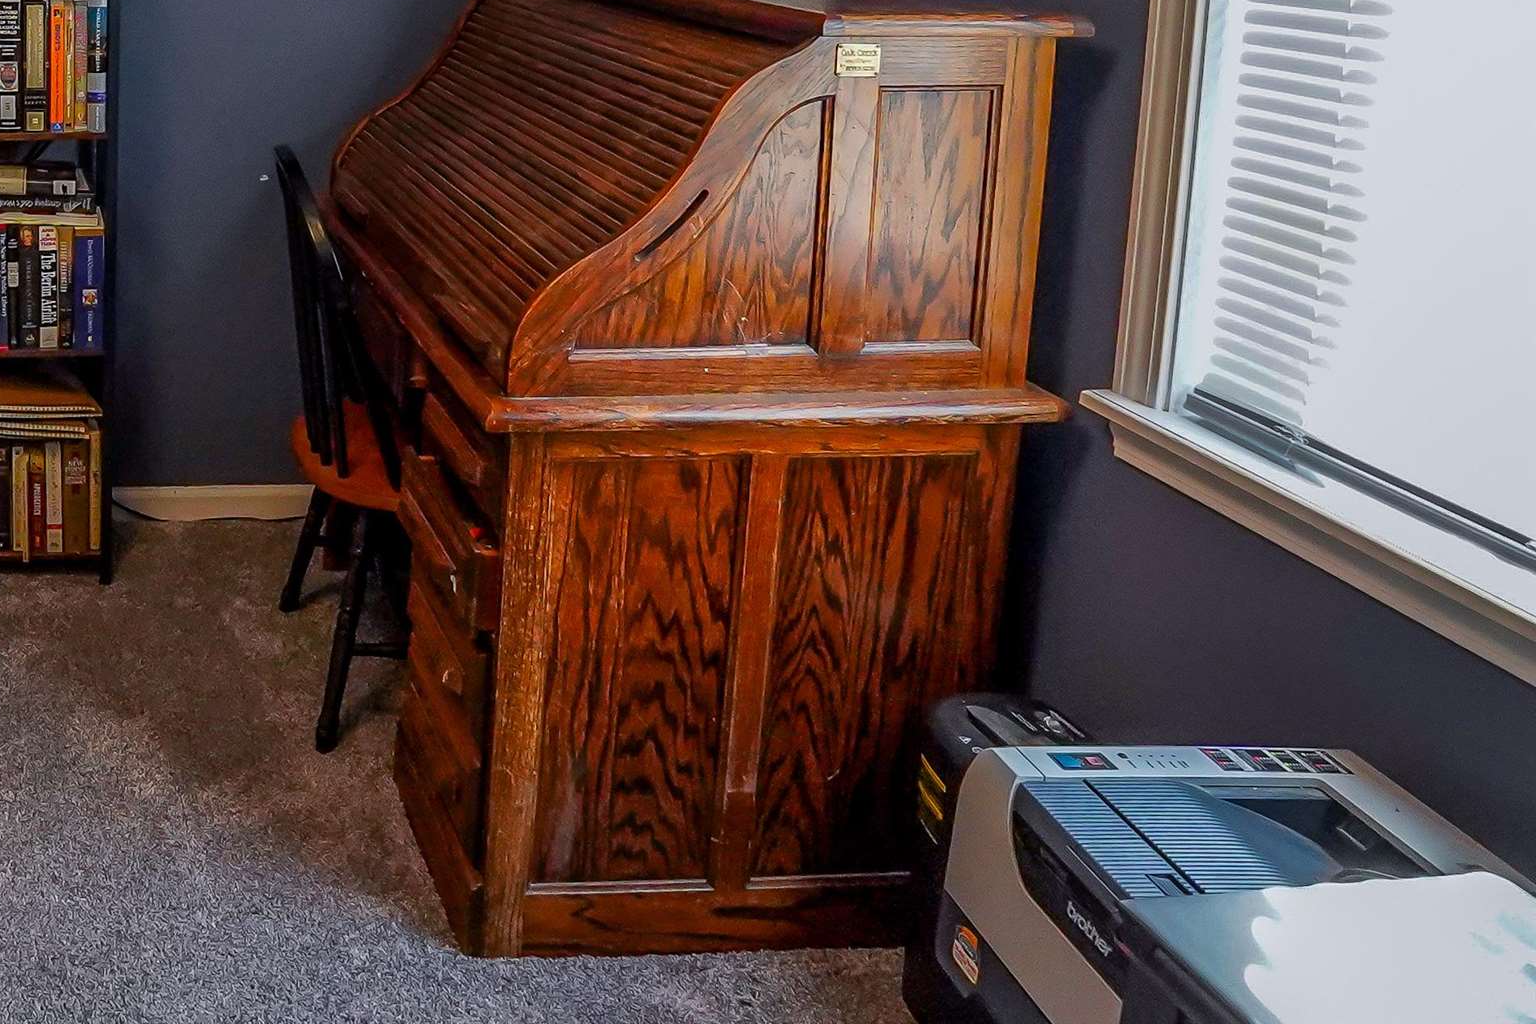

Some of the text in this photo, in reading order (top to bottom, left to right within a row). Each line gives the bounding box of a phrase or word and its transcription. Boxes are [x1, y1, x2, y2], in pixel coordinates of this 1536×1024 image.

[41, 253, 56, 324] The Berlin Airlift
[1066, 900, 1113, 957] brother
